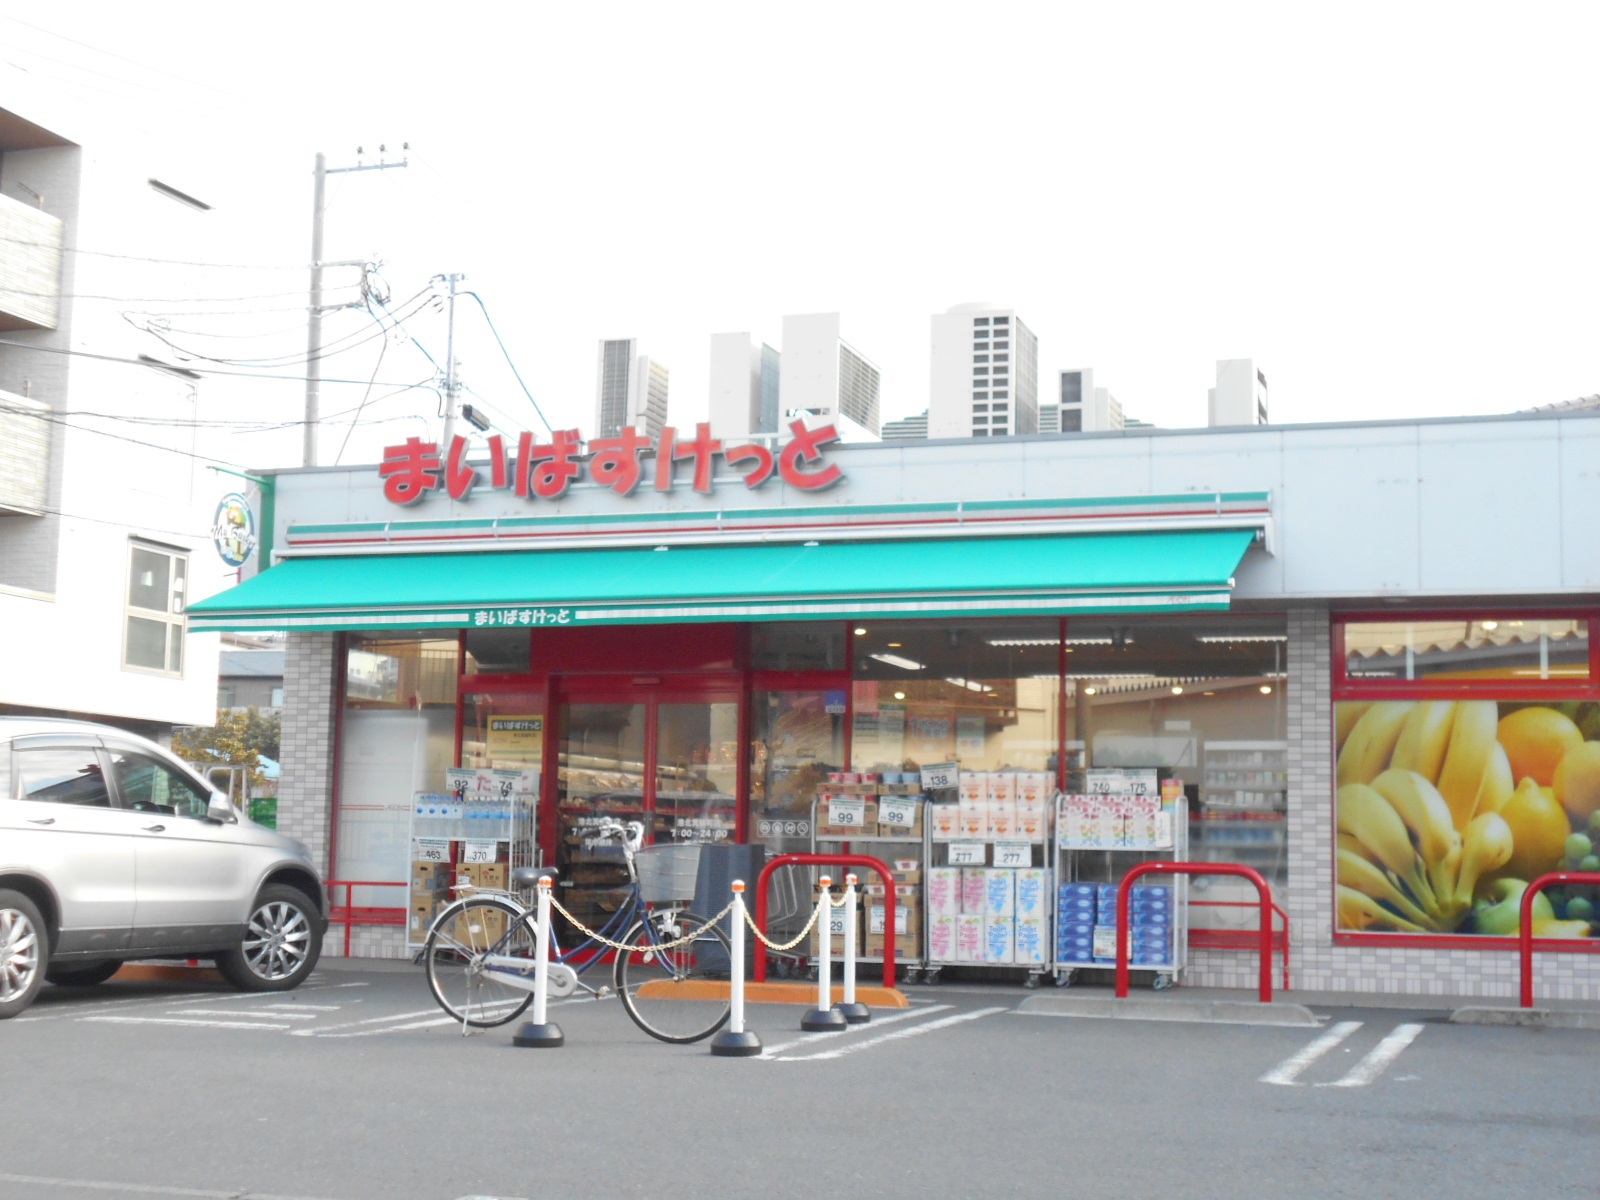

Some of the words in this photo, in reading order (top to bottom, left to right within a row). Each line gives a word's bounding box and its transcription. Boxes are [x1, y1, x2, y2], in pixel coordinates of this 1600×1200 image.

[379, 418, 845, 504] まいばすけっと
[474, 609, 570, 626] まいばすけっと
[492, 721, 541, 731] まいばすけっと
[930, 775, 949, 786] 138
[1130, 782, 1147, 793] 175
[838, 812, 853, 823] 99
[888, 811, 904, 823] 99
[472, 851, 487, 861] 370
[1003, 853, 1020, 864] 277
